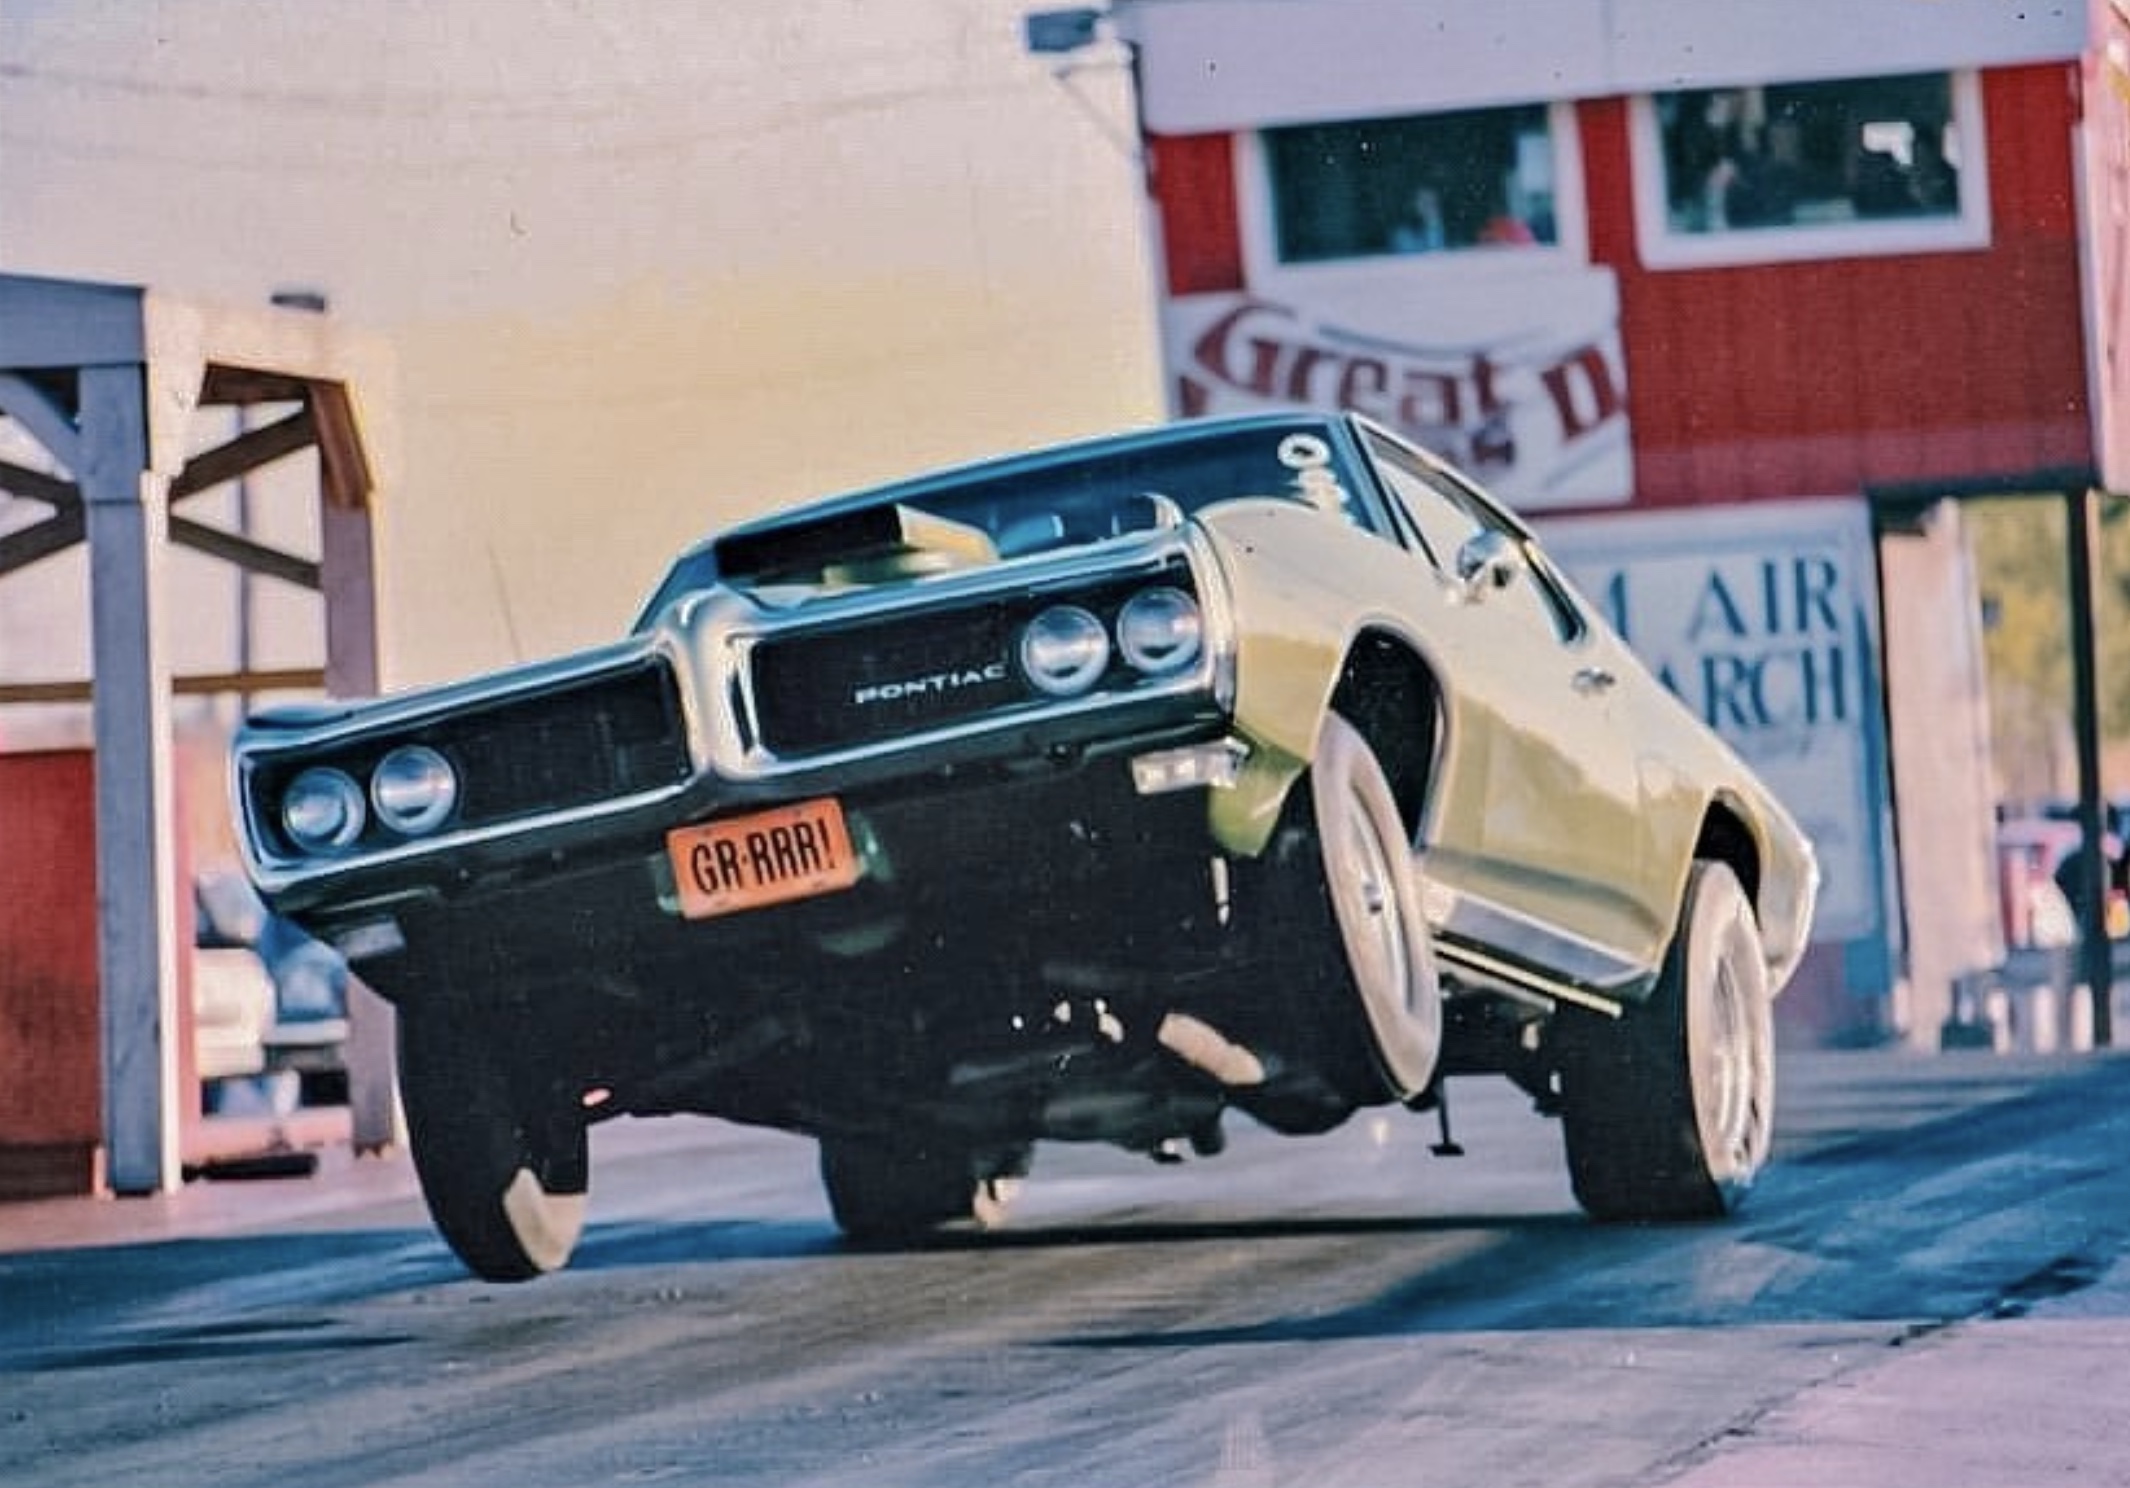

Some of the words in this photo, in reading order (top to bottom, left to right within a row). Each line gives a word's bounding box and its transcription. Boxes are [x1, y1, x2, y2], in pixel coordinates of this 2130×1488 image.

[1193, 302, 1501, 424] Great
[1685, 558, 1840, 641] AIR
[855, 663, 1005, 704] PONTIAC
